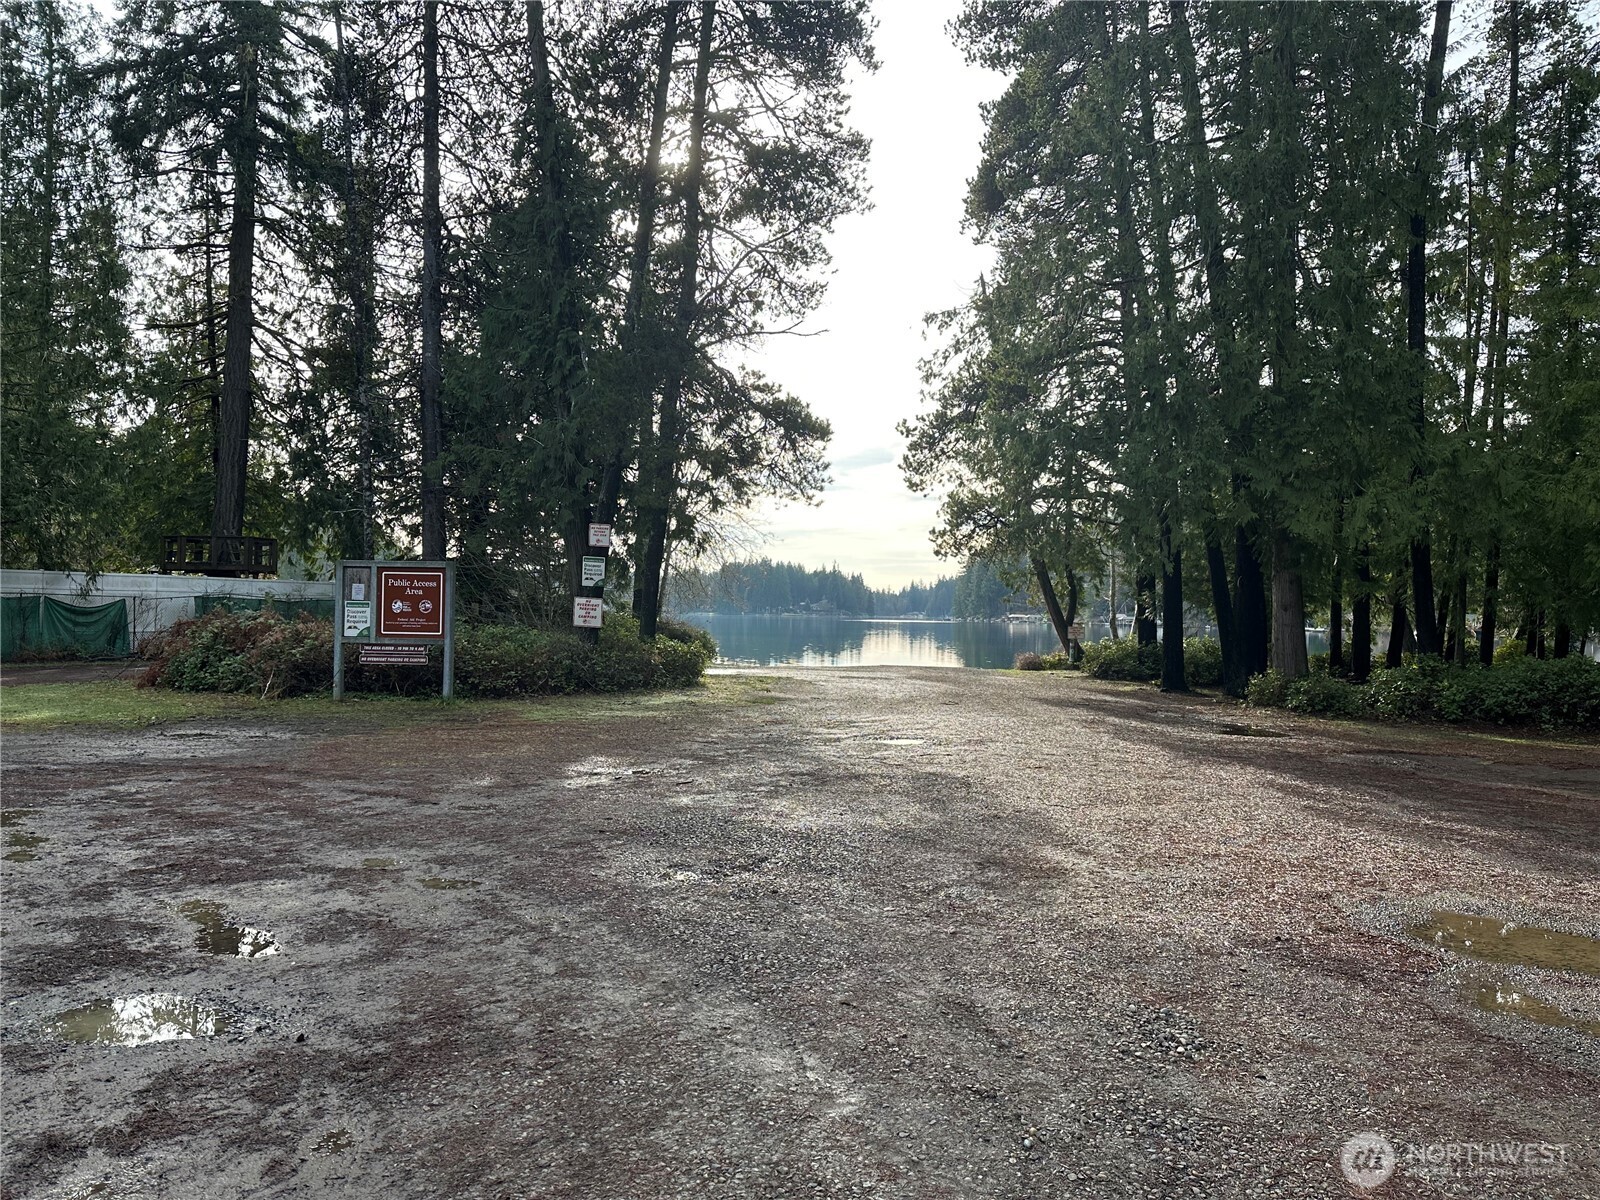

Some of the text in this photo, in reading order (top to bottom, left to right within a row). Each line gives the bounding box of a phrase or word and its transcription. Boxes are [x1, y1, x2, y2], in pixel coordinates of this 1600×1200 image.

[388, 579, 437, 588] Public Access
[405, 587, 423, 595] Area
